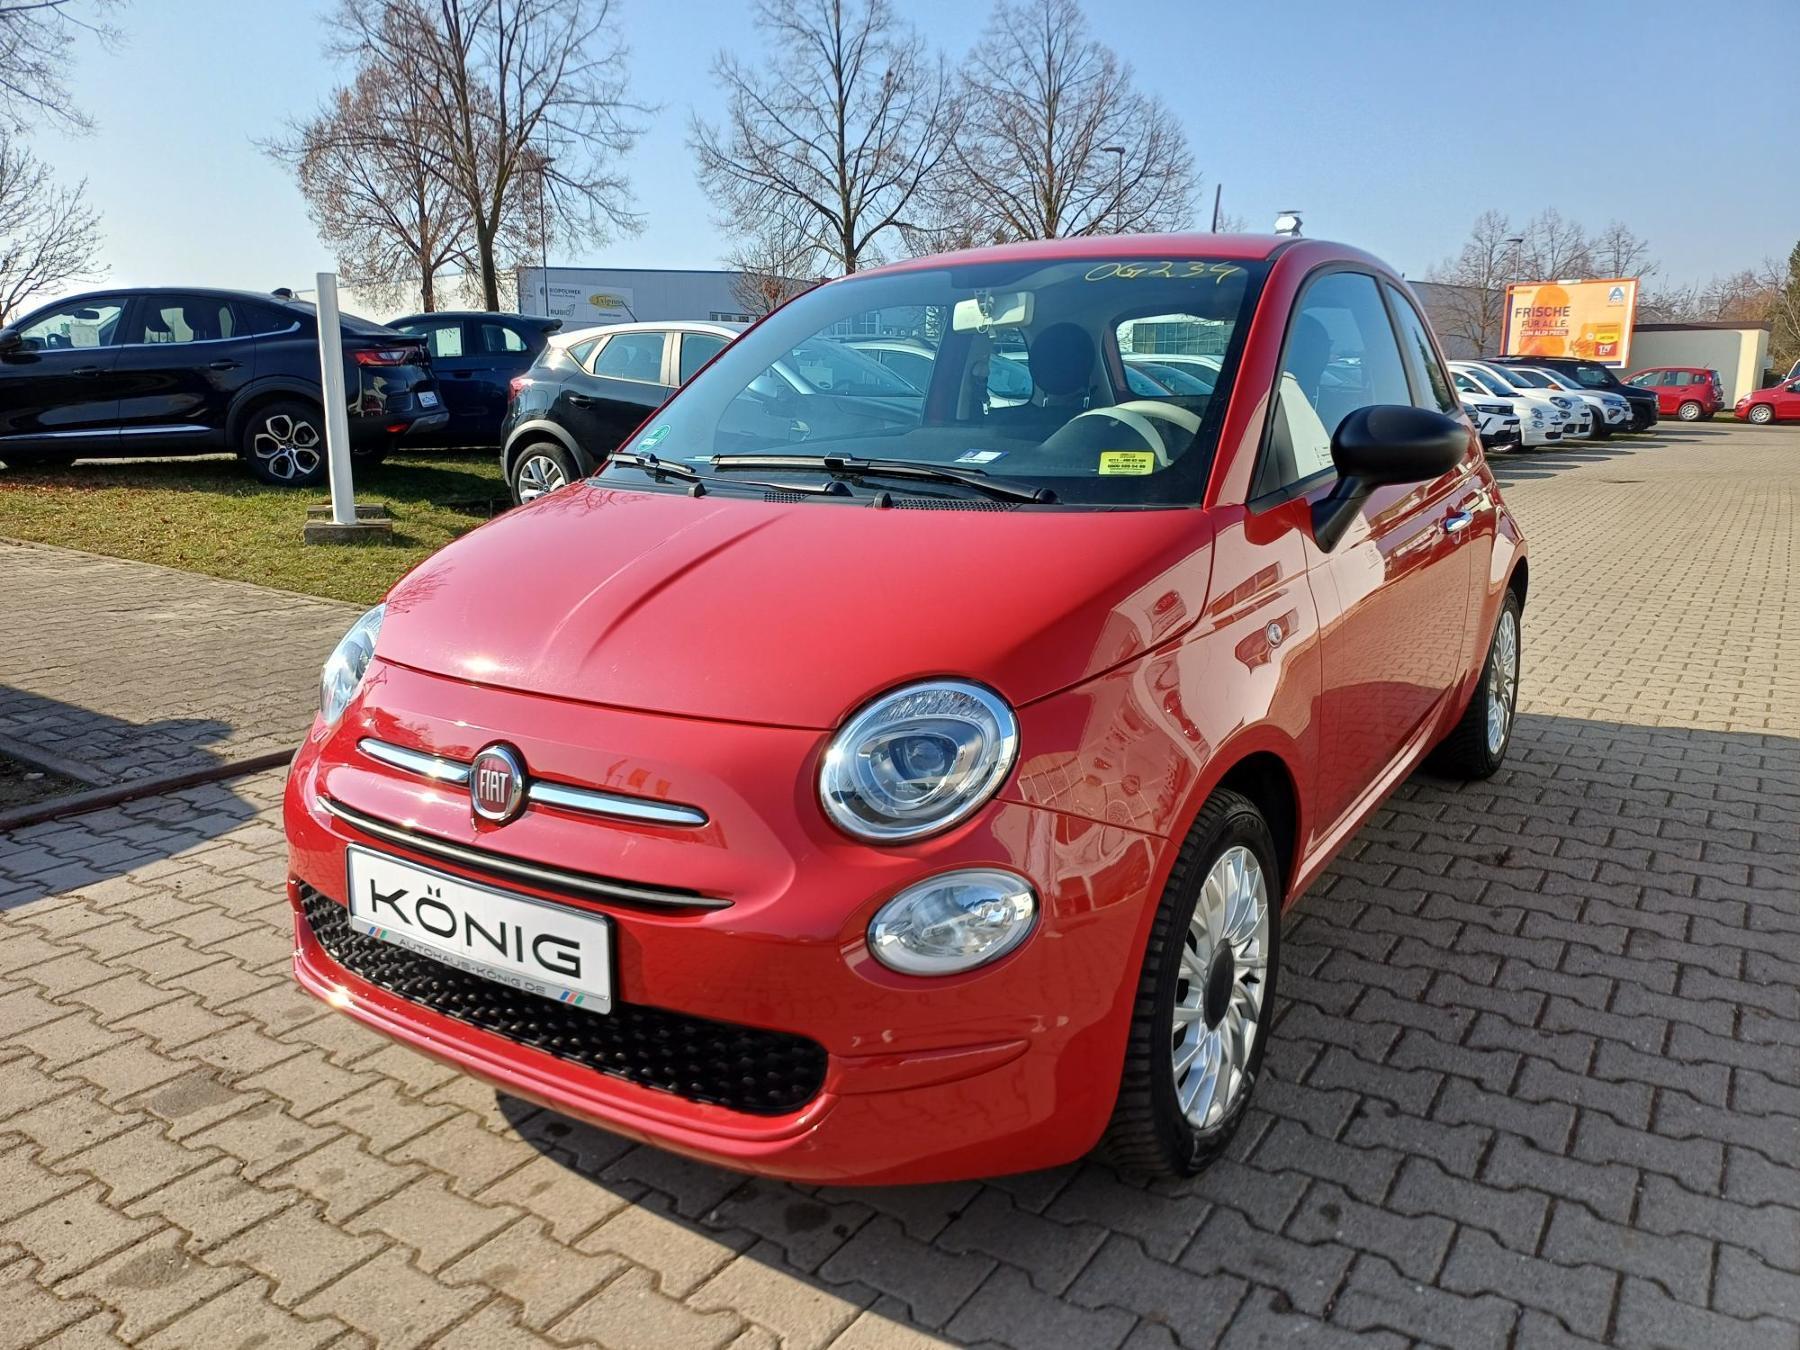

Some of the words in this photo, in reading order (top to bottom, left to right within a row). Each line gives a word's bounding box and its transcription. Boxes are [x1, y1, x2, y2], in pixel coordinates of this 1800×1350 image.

[1515, 306, 1571, 318] FRISCHE
[480, 769, 510, 803] FIAT
[370, 879, 582, 979] KÖNIG
